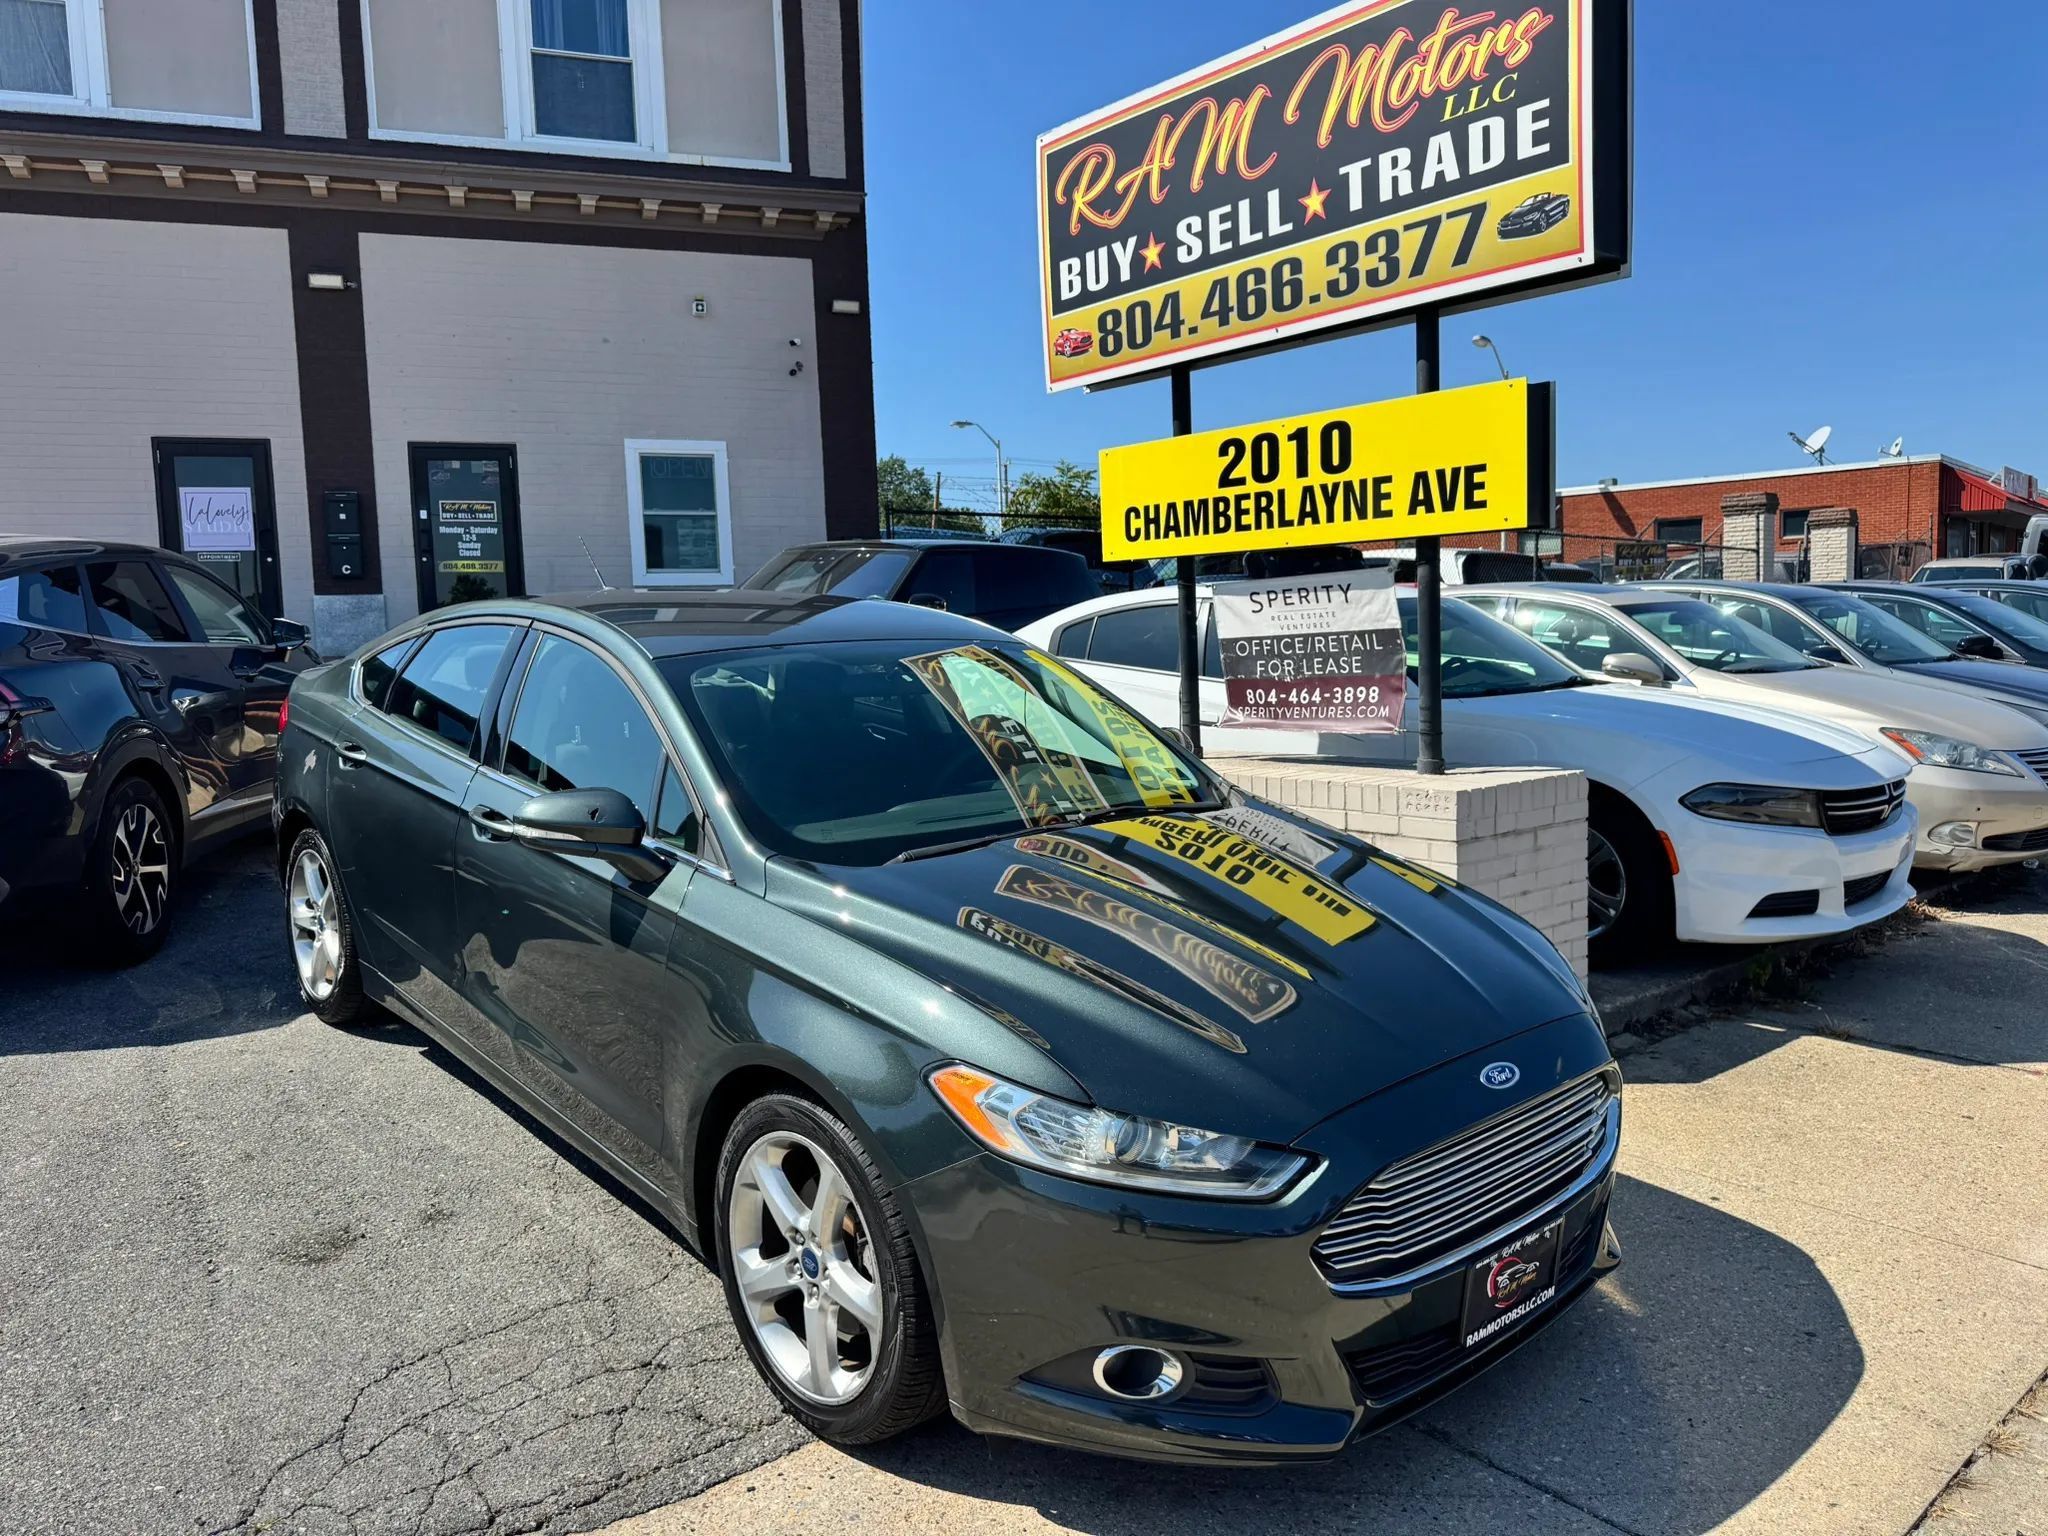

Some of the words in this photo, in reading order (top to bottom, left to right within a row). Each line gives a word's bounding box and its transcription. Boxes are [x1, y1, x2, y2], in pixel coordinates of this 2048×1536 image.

[1440, 72, 1518, 123] LLC
[1055, 84, 1278, 236] RAM
[1284, 6, 1553, 149] Motors
[1059, 235, 1138, 301] BUY
[1175, 188, 1294, 265] SELL
[1339, 97, 1551, 211] TRADE
[1098, 201, 1489, 358] 804.466.3377
[1218, 420, 1352, 489] 2010
[1124, 475, 1394, 542] CHAMBERLAYNE
[1407, 463, 1488, 516] AVE
[184, 519, 252, 533] STUDIO
[439, 526, 465, 535] Monday
[470, 526, 498, 535] Saturday
[457, 541, 482, 550] Sunday
[458, 549, 481, 557] Closed
[341, 564, 352, 575] C
[1250, 583, 1352, 614] SPERITY
[1270, 613, 1295, 622] REAL
[1300, 611, 1337, 620] ESTATE
[1279, 621, 1331, 631] VENTURES
[1235, 632, 1383, 657] OFFICE/RETAIL
[1256, 659, 1295, 677] FOR
[1302, 656, 1363, 675] LEASE
[1246, 685, 1380, 705] 804-464-3898
[1237, 705, 1390, 719] SPERITYVENTURES.COM
[1488, 1067, 1513, 1084] Ford
[1466, 1284, 1556, 1348] RAMMOTORSLLC.COM
